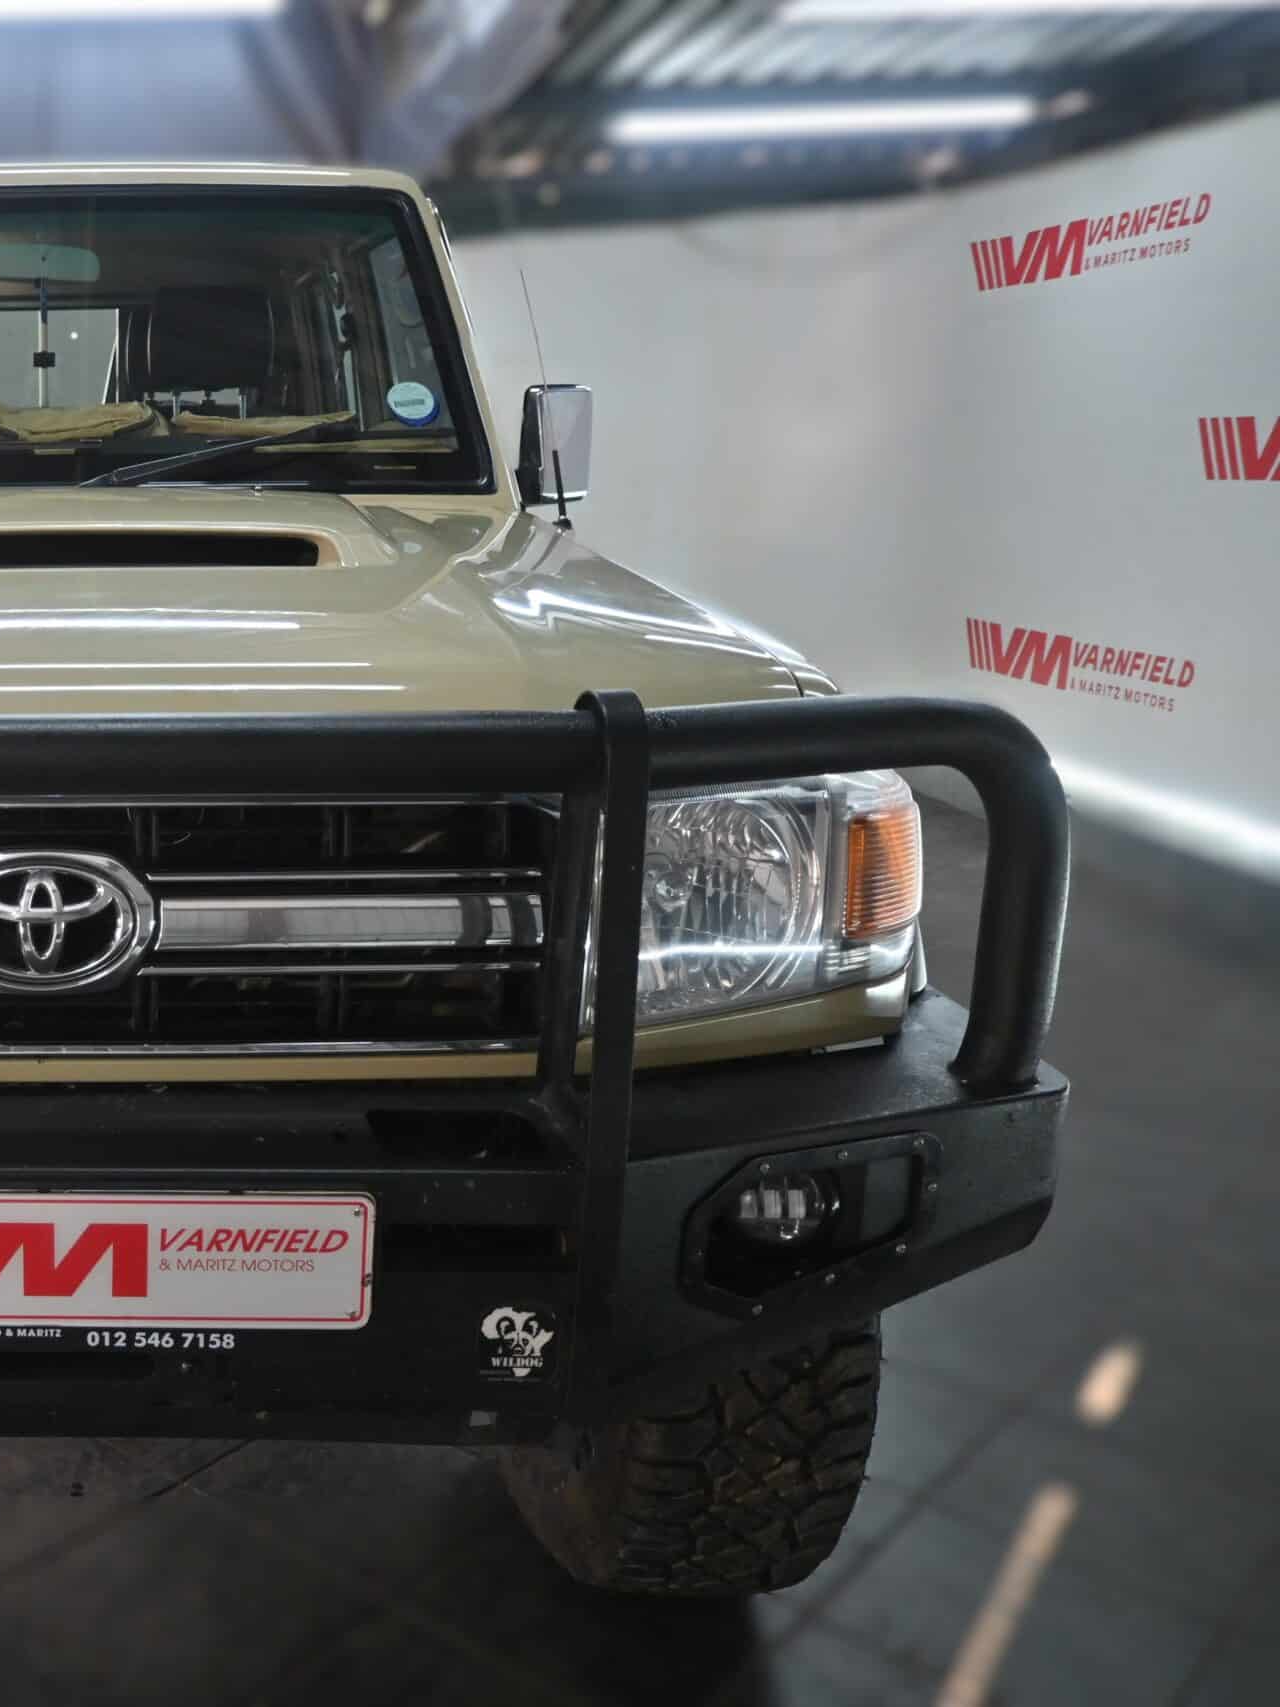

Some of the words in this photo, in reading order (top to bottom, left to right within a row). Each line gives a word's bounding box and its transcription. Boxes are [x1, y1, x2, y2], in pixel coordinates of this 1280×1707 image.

[1086, 193, 1212, 246] VARNFIELD
[998, 217, 1088, 287] VM
[1093, 248, 1136, 269] MARITZ
[1138, 238, 1191, 260] MOTORS
[989, 622, 1072, 690] VM
[1073, 641, 1195, 688] VARNFIELD
[1079, 680, 1121, 700] MARITZ
[1124, 690, 1175, 712] MOTORS
[159, 1227, 349, 1253] VARNFIELD
[159, 1258, 170, 1272] &
[177, 1258, 237, 1272] MARITZ
[241, 1259, 315, 1273] MOTORS
[5, 1328, 14, 1338] &
[17, 1328, 63, 1338] MARITZ
[86, 1331, 127, 1347] 012
[133, 1332, 174, 1348] 546
[181, 1333, 235, 1349] 7158
